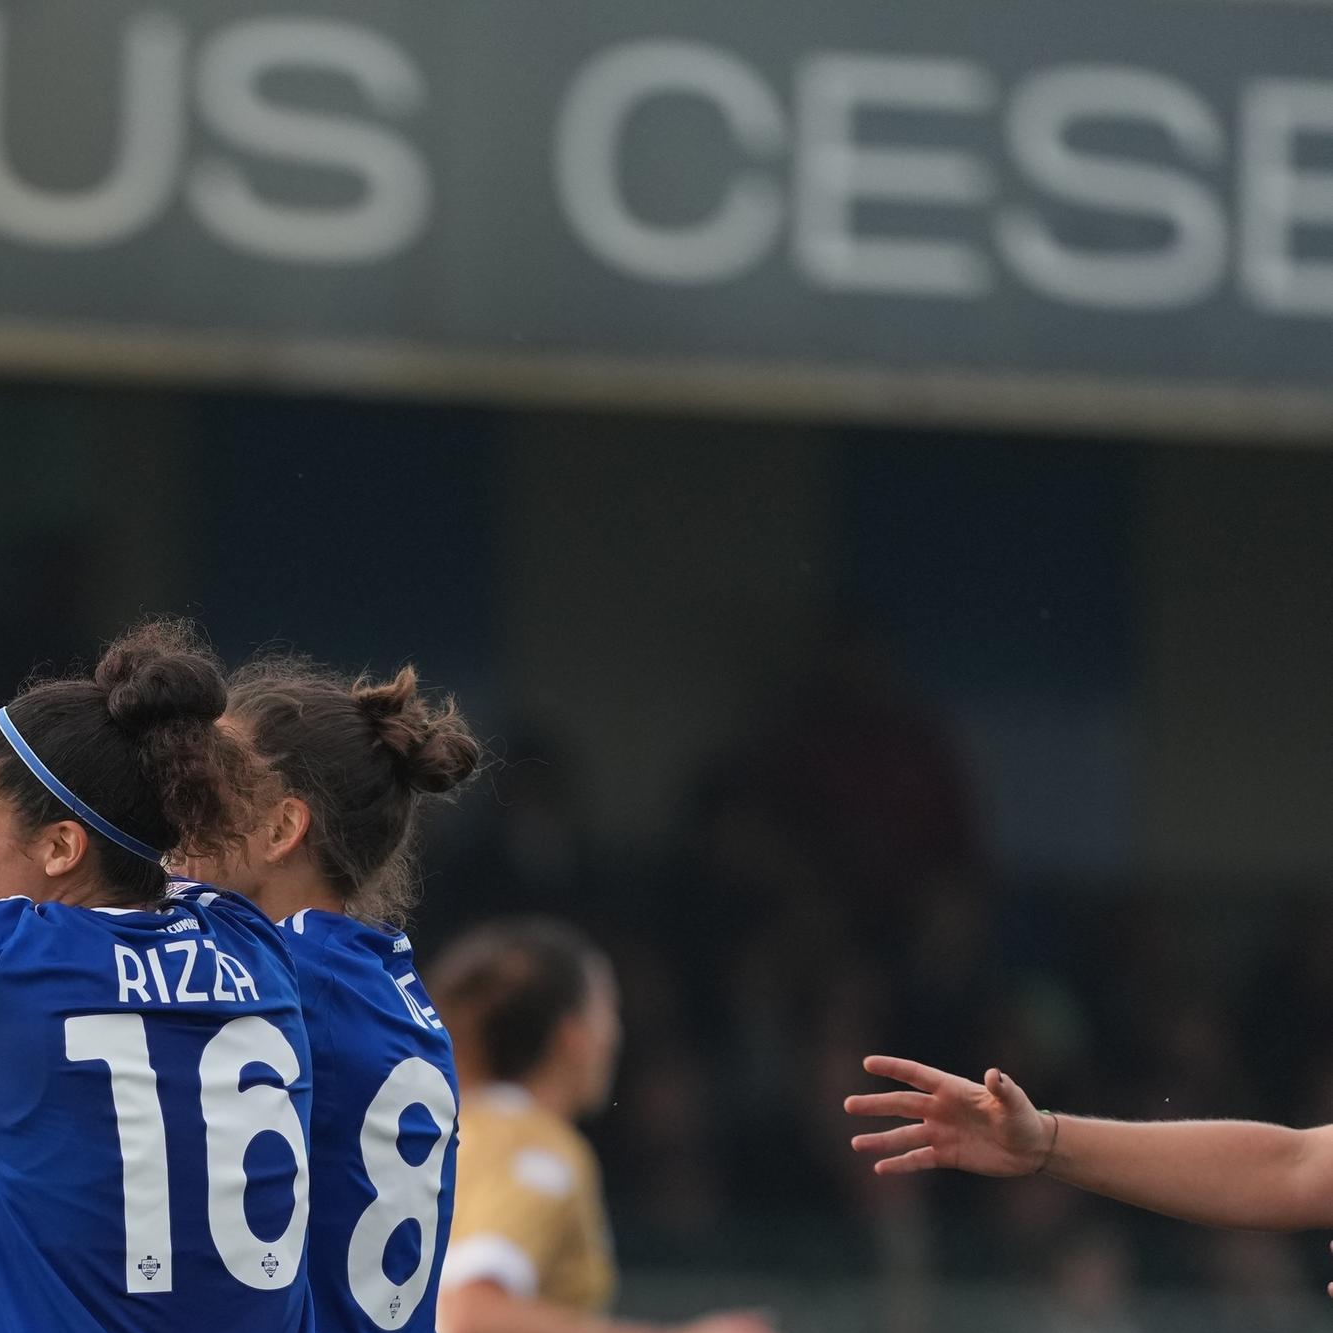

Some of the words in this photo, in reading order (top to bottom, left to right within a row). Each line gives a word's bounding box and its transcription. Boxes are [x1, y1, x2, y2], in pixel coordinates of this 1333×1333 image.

[114, 939, 260, 1004] RIZZA
[64, 1013, 309, 1293] 16
[347, 1056, 458, 1331] 8
